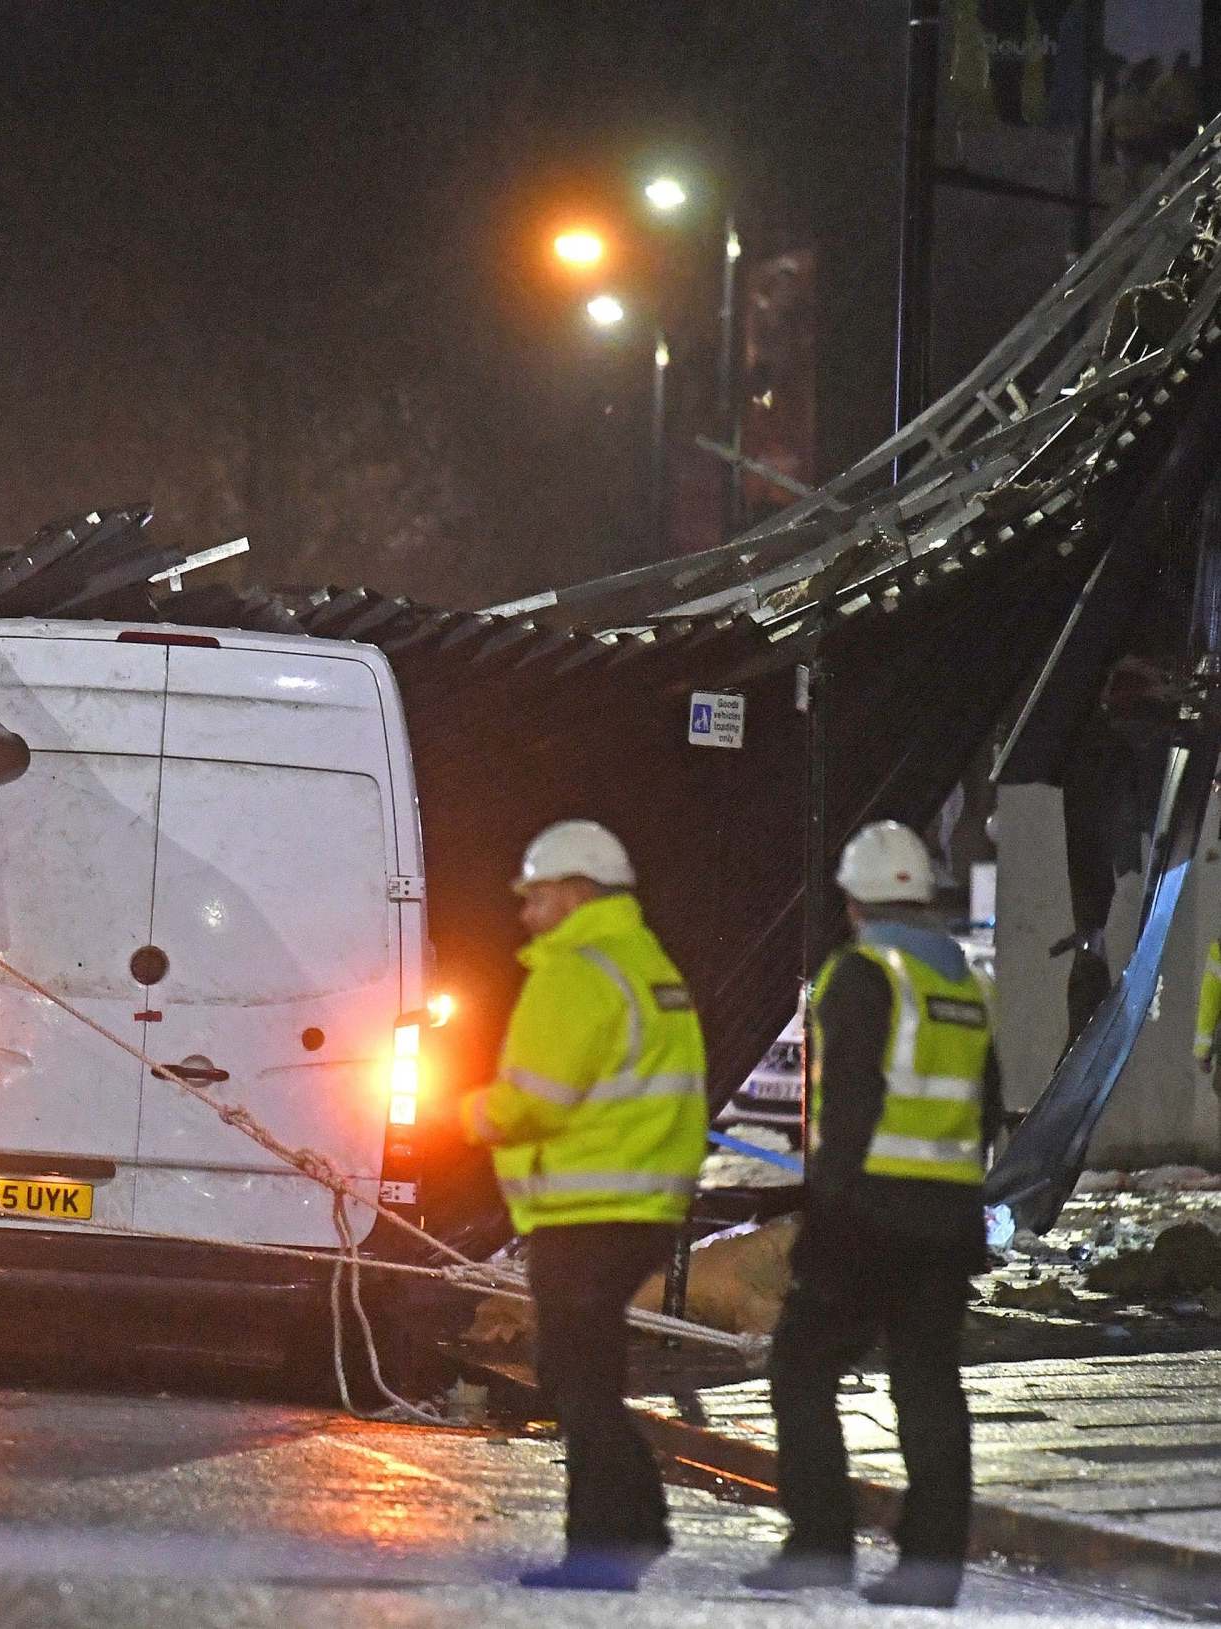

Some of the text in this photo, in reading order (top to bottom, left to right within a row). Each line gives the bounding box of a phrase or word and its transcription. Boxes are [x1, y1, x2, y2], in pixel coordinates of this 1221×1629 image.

[718, 699, 738, 709] Goods
[719, 734, 734, 744] only
[27, 1186, 79, 1213] UYK
